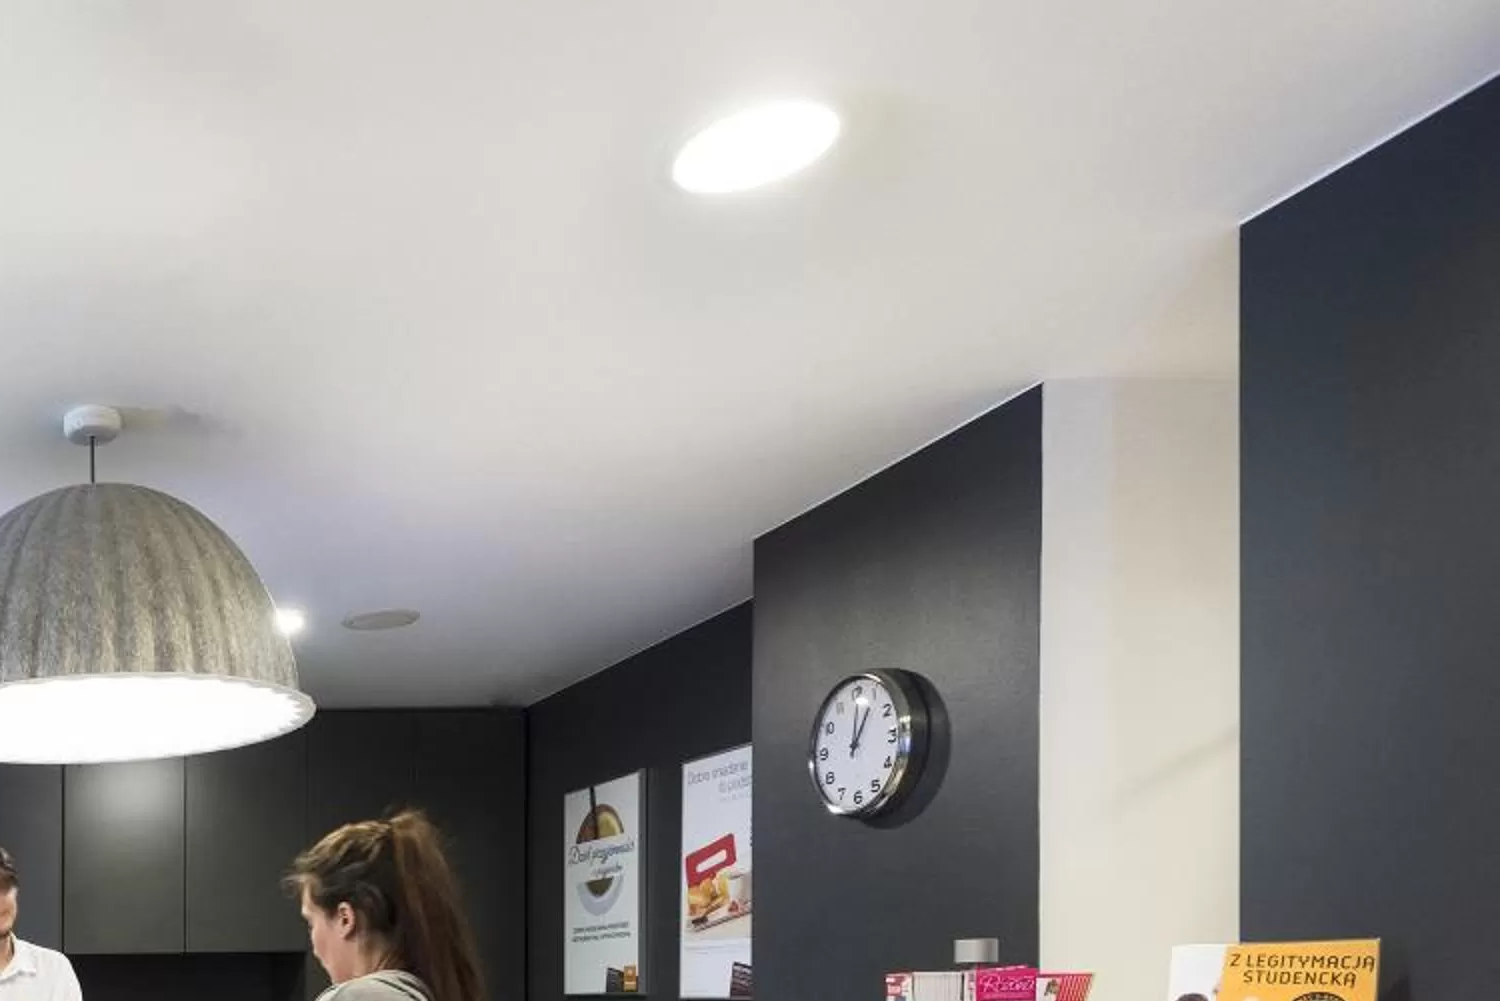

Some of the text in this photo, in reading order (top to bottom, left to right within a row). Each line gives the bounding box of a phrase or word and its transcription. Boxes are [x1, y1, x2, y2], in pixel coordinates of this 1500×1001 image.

[883, 703, 892, 717] 2
[888, 728, 897, 744] 3
[820, 748, 829, 761] 9
[883, 755, 892, 769] 4
[825, 771, 835, 785] 8
[871, 779, 881, 792] 5
[837, 787, 846, 800] 7
[853, 791, 863, 804] 6
[1230, 953, 1376, 973] Z LEGITYMACJĄ
[1243, 970, 1357, 989] STUDENCKĄ
